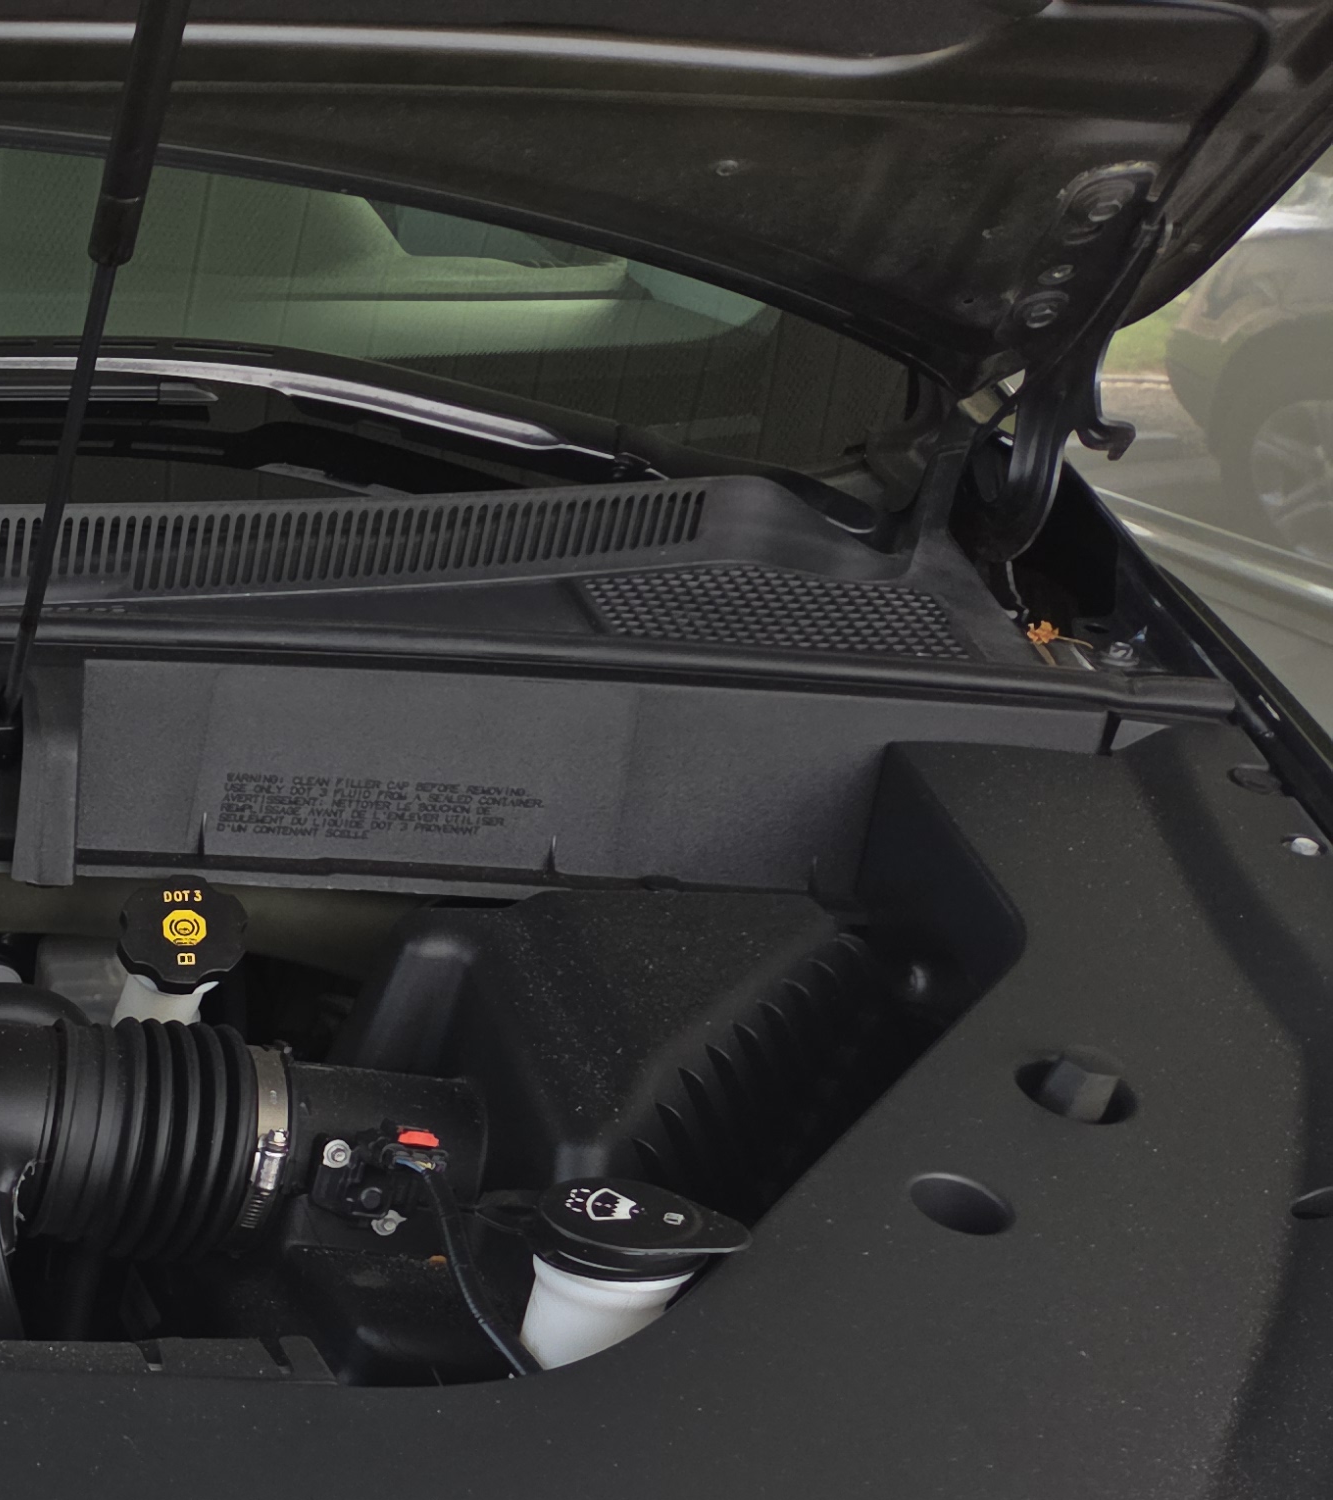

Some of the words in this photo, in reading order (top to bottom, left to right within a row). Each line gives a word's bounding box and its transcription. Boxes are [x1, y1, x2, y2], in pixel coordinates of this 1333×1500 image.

[223, 782, 246, 793] USE
[253, 783, 288, 794] ONLY
[290, 785, 313, 795] DOT
[319, 786, 328, 797] 3
[333, 788, 372, 799] FLUID
[377, 789, 407, 800] FROM
[412, 792, 422, 802] A
[428, 793, 473, 804] SEALED
[292, 775, 330, 787] CLEAN
[334, 777, 382, 789] FILLER
[386, 780, 410, 790] CAP
[415, 781, 461, 793] BEFORE
[220, 801, 301, 816] REMPLISSAGE
[307, 807, 345, 819] AVANT
[351, 810, 367, 820] DE
[444, 815, 505, 827] UTILISER
[396, 801, 413, 812] LE
[418, 803, 471, 814] BOUCHON
[476, 806, 492, 816] DE
[218, 812, 284, 825] SEULEMENT
[291, 817, 308, 826] DU
[370, 821, 393, 832] DOT
[400, 822, 409, 832] 3
[413, 823, 481, 836] PROVENANT
[252, 824, 319, 837] CONTENANT
[163, 889, 191, 903] DOT
[193, 889, 203, 902] 3
